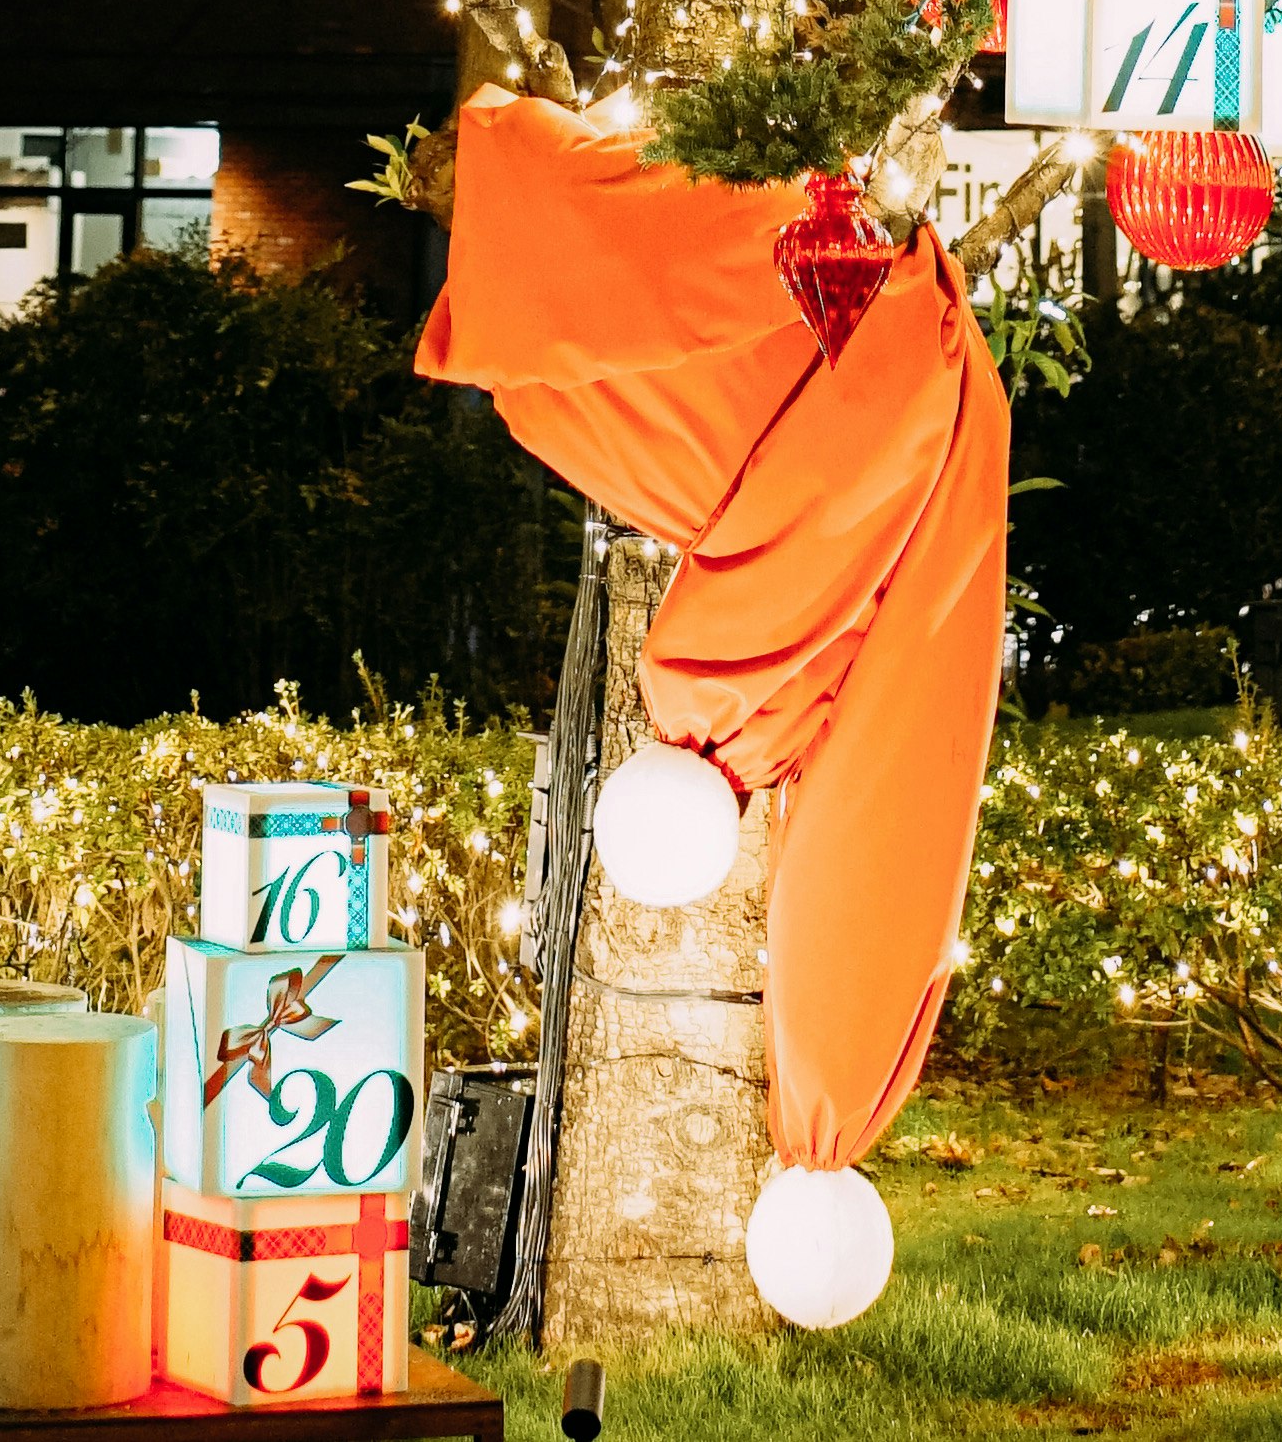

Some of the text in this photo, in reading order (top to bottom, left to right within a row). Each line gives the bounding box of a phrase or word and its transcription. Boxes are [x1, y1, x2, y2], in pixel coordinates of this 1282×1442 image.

[1101, 2, 1208, 115] 14
[250, 850, 347, 944] 16
[236, 1068, 415, 1191] 20
[243, 1273, 353, 1395] 5
